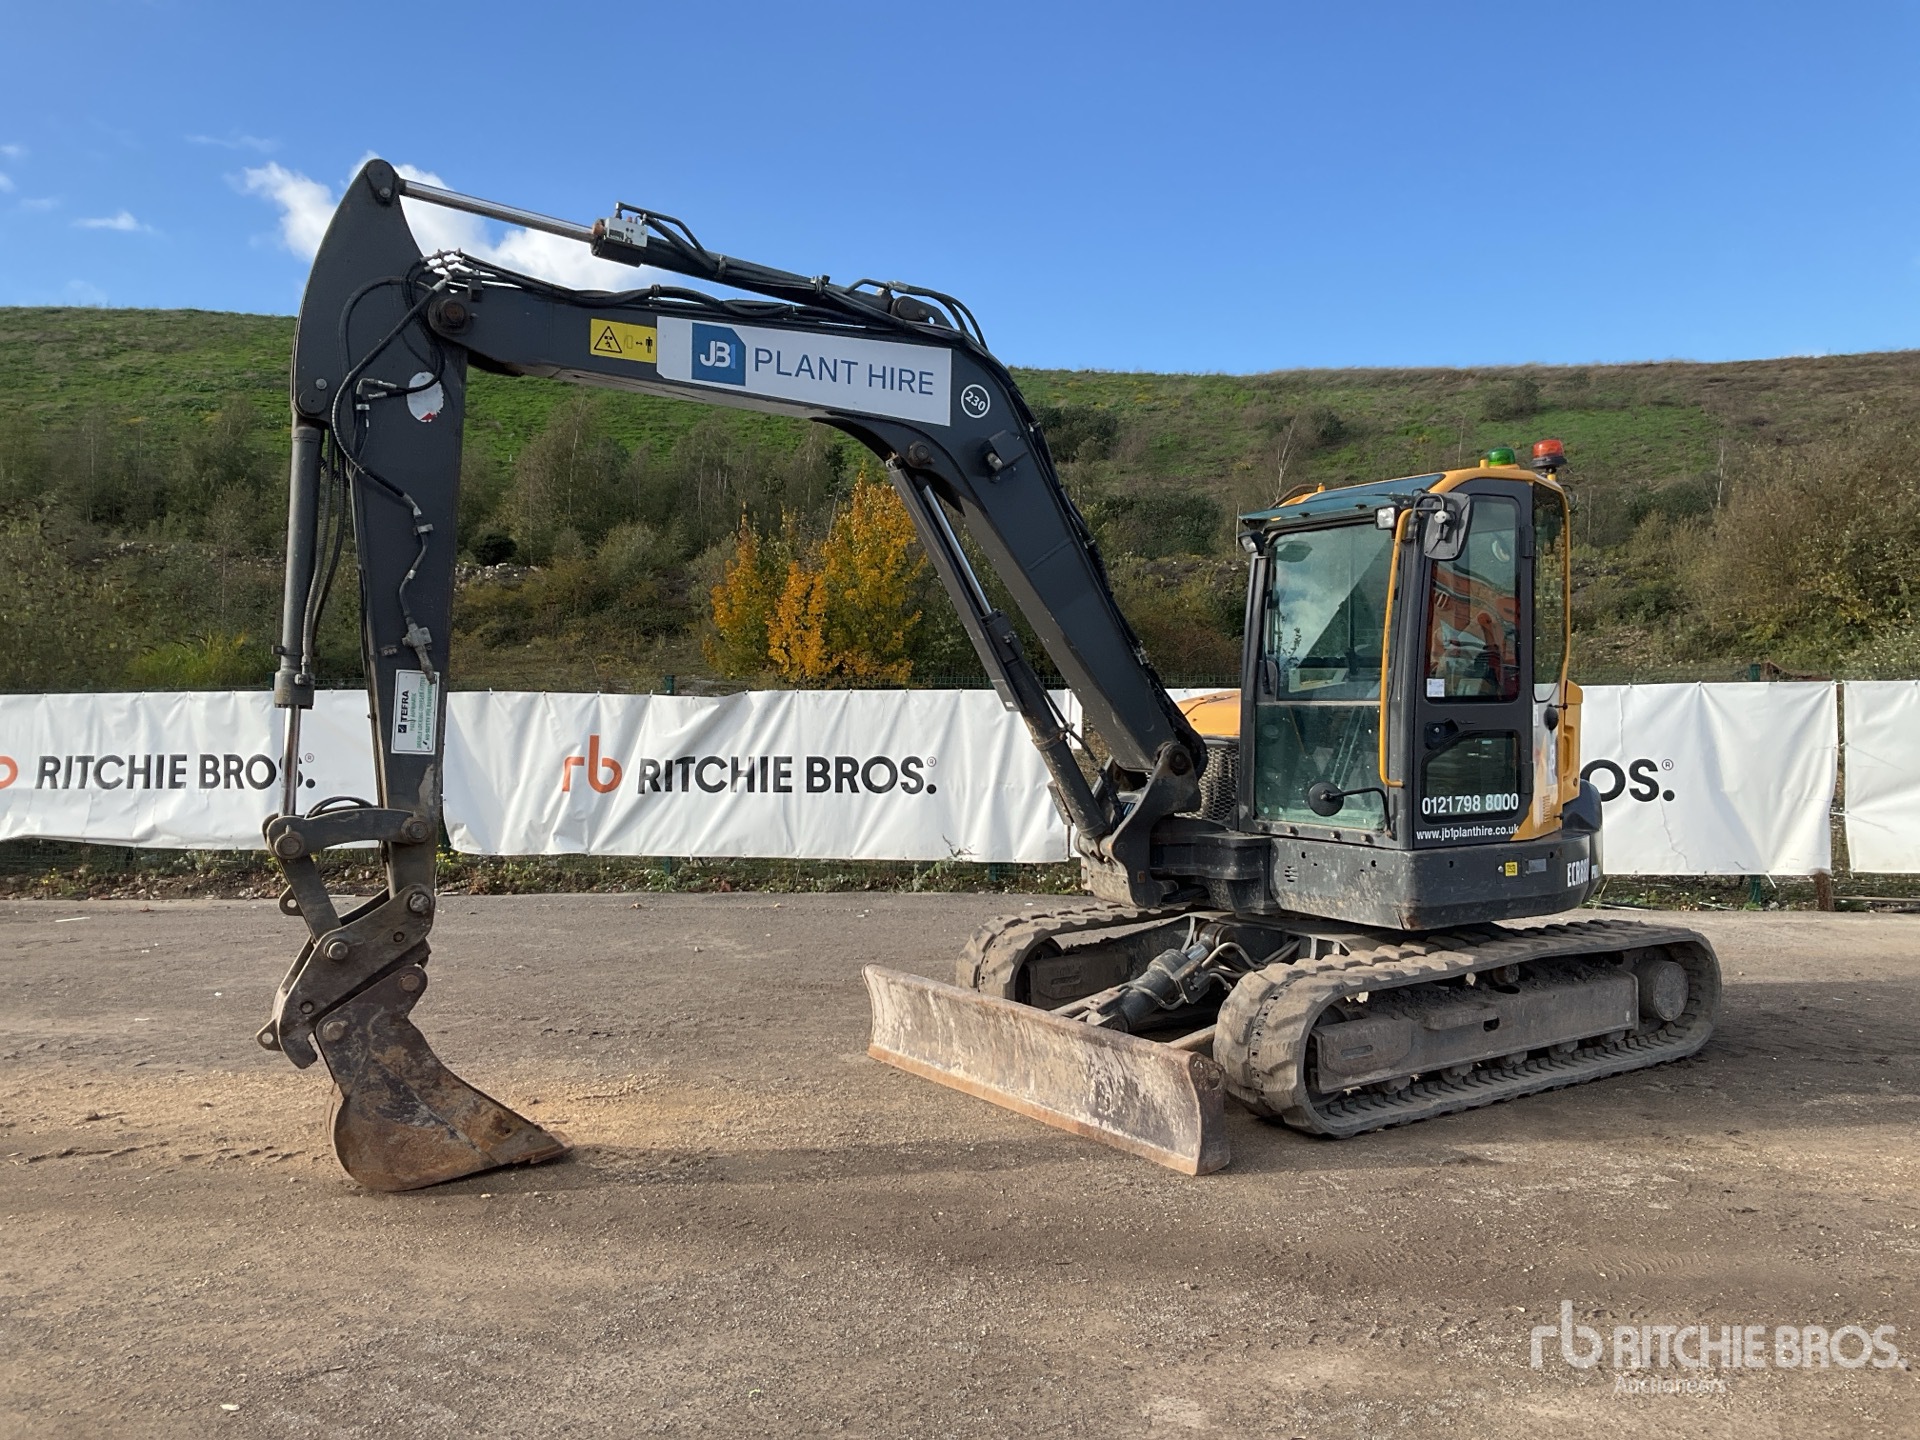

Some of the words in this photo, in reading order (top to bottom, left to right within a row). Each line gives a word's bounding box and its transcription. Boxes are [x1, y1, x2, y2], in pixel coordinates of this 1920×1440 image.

[754, 346, 859, 385] PLANT
[867, 364, 934, 396] HIRE
[965, 391, 986, 411] 230
[401, 690, 409, 722] TEFRA
[35, 754, 188, 790] RITCHIE
[562, 734, 623, 794] rb
[638, 756, 793, 795] RITCHIE
[806, 756, 938, 795] BROS.
[1485, 793, 1519, 811] 8000
[1416, 823, 1520, 841] www.jb1planthire.co.uk
